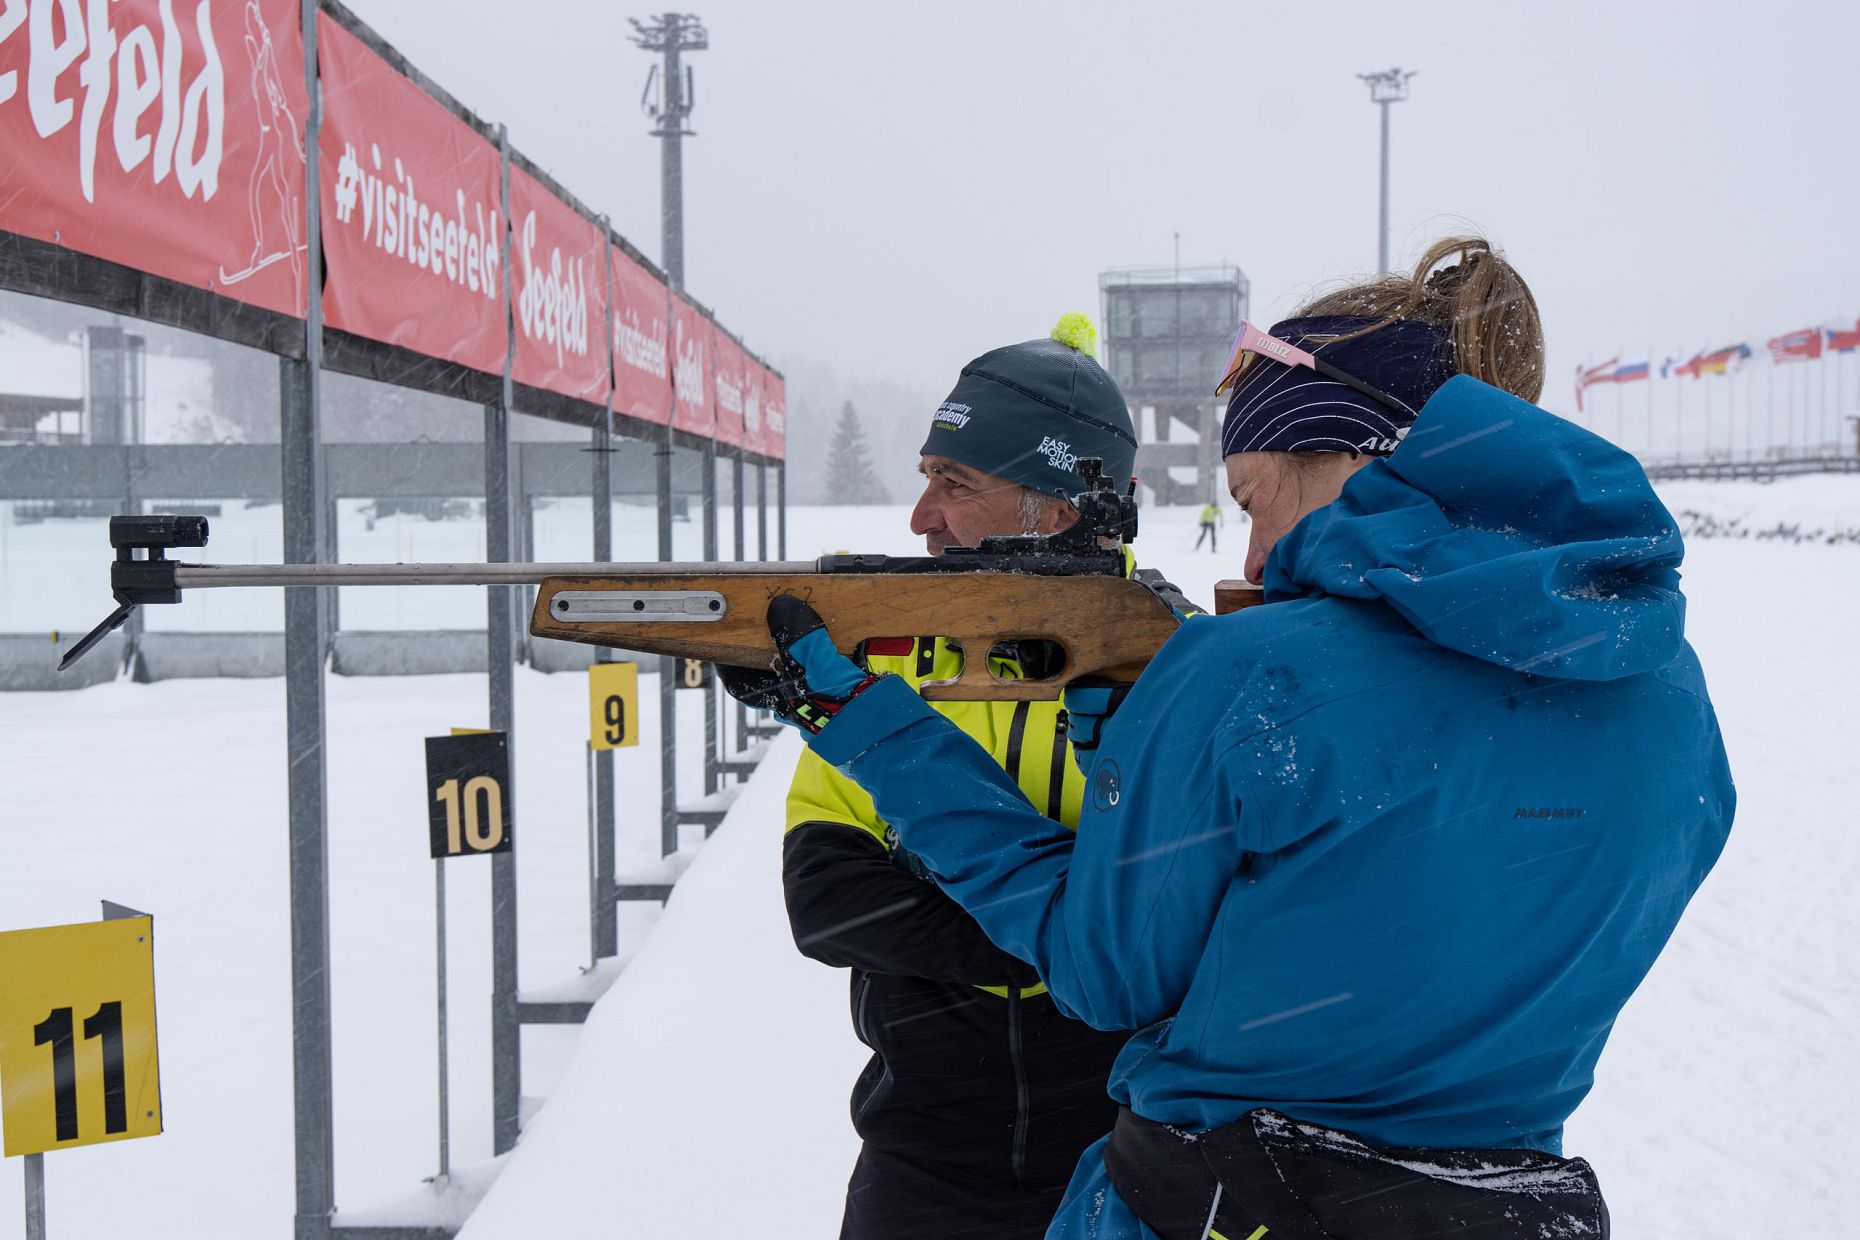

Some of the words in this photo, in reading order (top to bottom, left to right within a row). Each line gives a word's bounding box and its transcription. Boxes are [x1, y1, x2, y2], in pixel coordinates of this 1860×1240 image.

[335, 143, 499, 299] #visitseefeld
[520, 210, 588, 368] Seefeld
[1043, 436, 1071, 453] EASY
[1048, 457, 1076, 473] SKIN
[605, 695, 625, 745] 9
[436, 776, 503, 854] 10
[34, 1001, 127, 1141] 11
